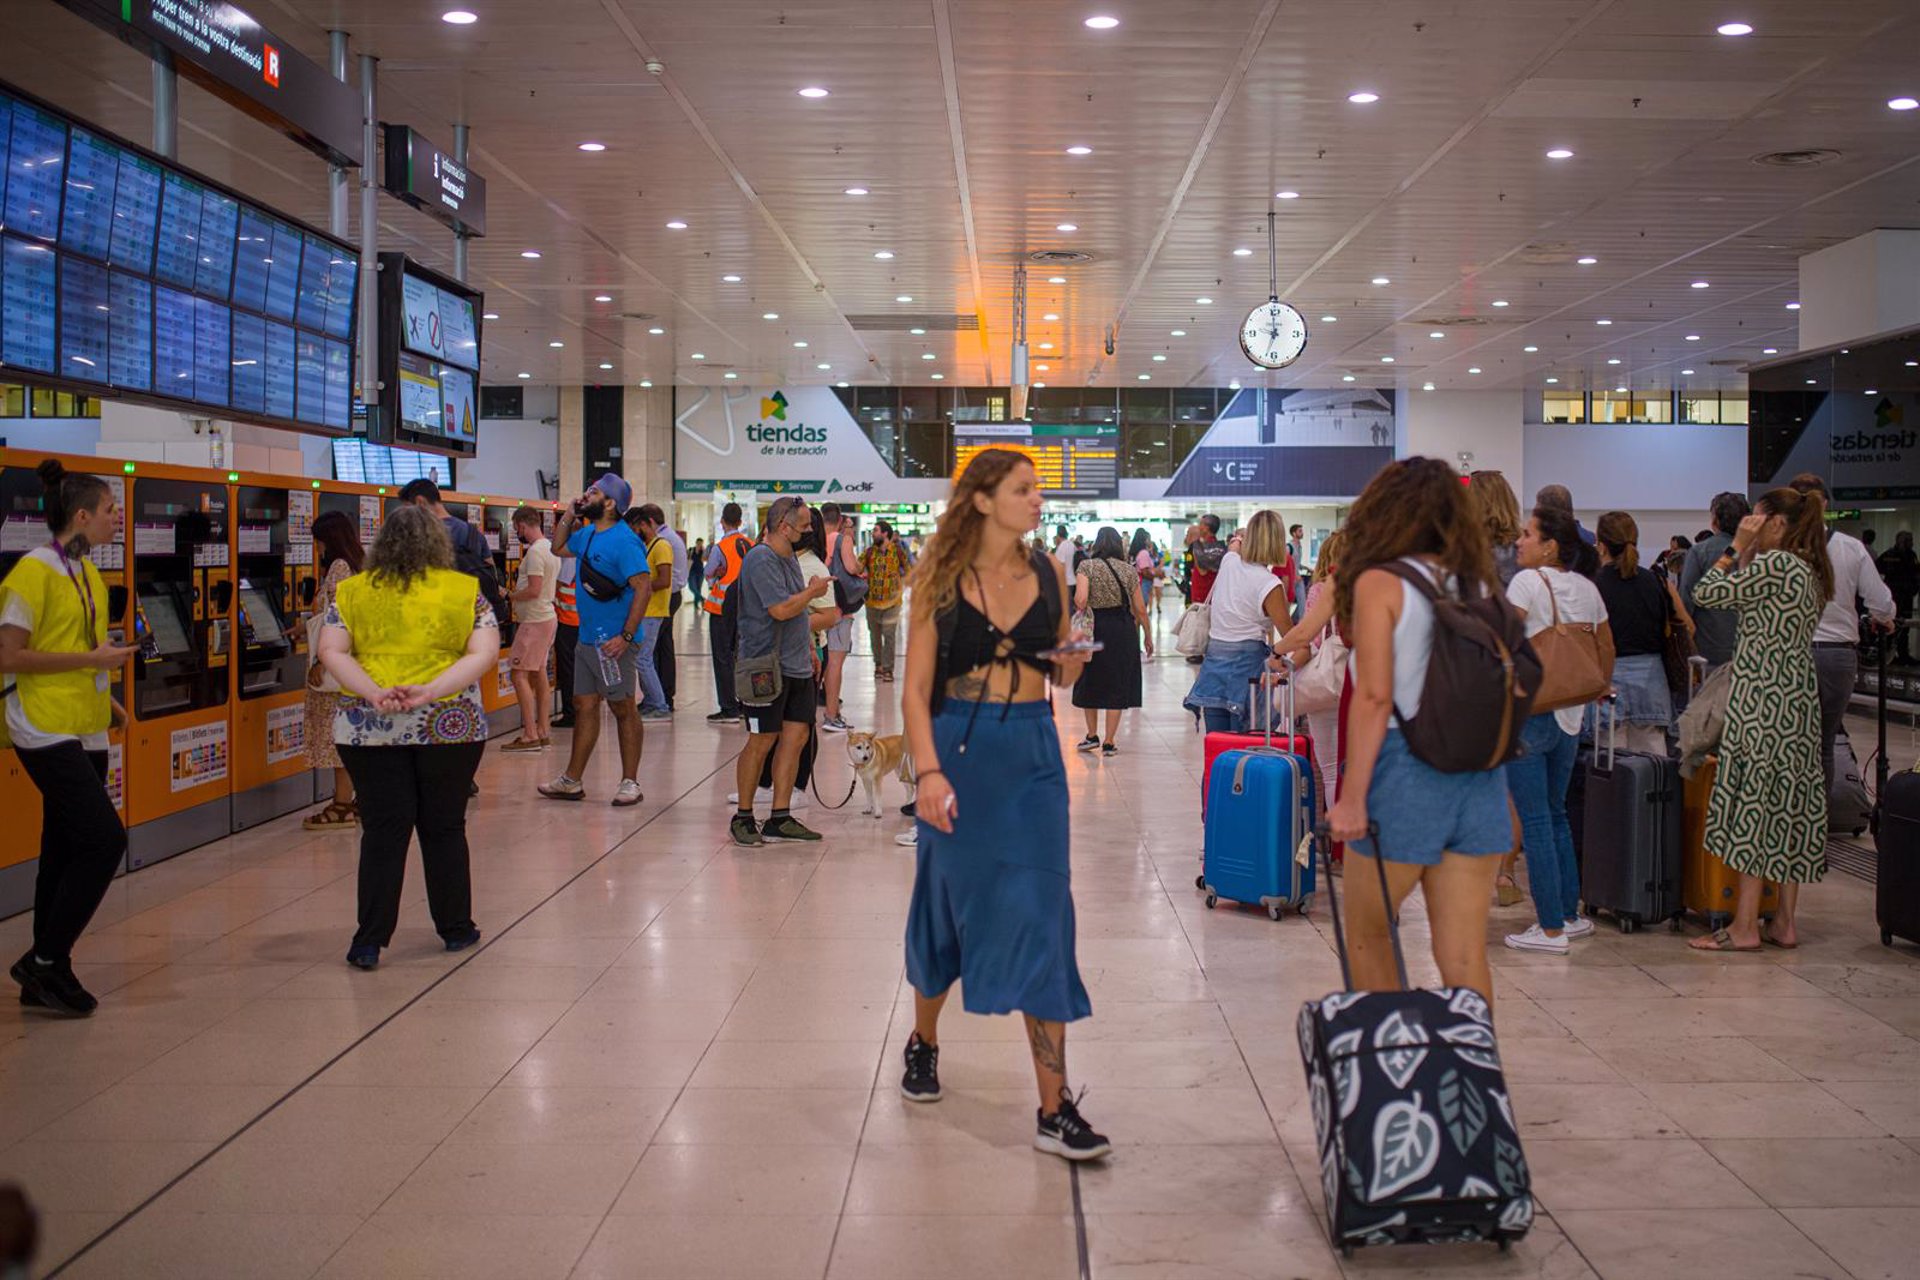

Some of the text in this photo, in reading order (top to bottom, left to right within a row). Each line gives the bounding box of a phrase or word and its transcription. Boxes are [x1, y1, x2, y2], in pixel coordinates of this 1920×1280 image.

[179, 6, 194, 26] tren
[195, 19, 200, 31] a
[201, 19, 209, 36] la
[209, 28, 230, 50] vostra
[230, 40, 262, 72] destinació
[269, 51, 279, 78] R
[746, 423, 827, 442] tiendas
[761, 445, 828, 455] de la estación
[1226, 462, 1236, 480] C
[729, 482, 769, 490] Restauració
[789, 482, 814, 490] Serveis
[845, 482, 873, 492] adif
